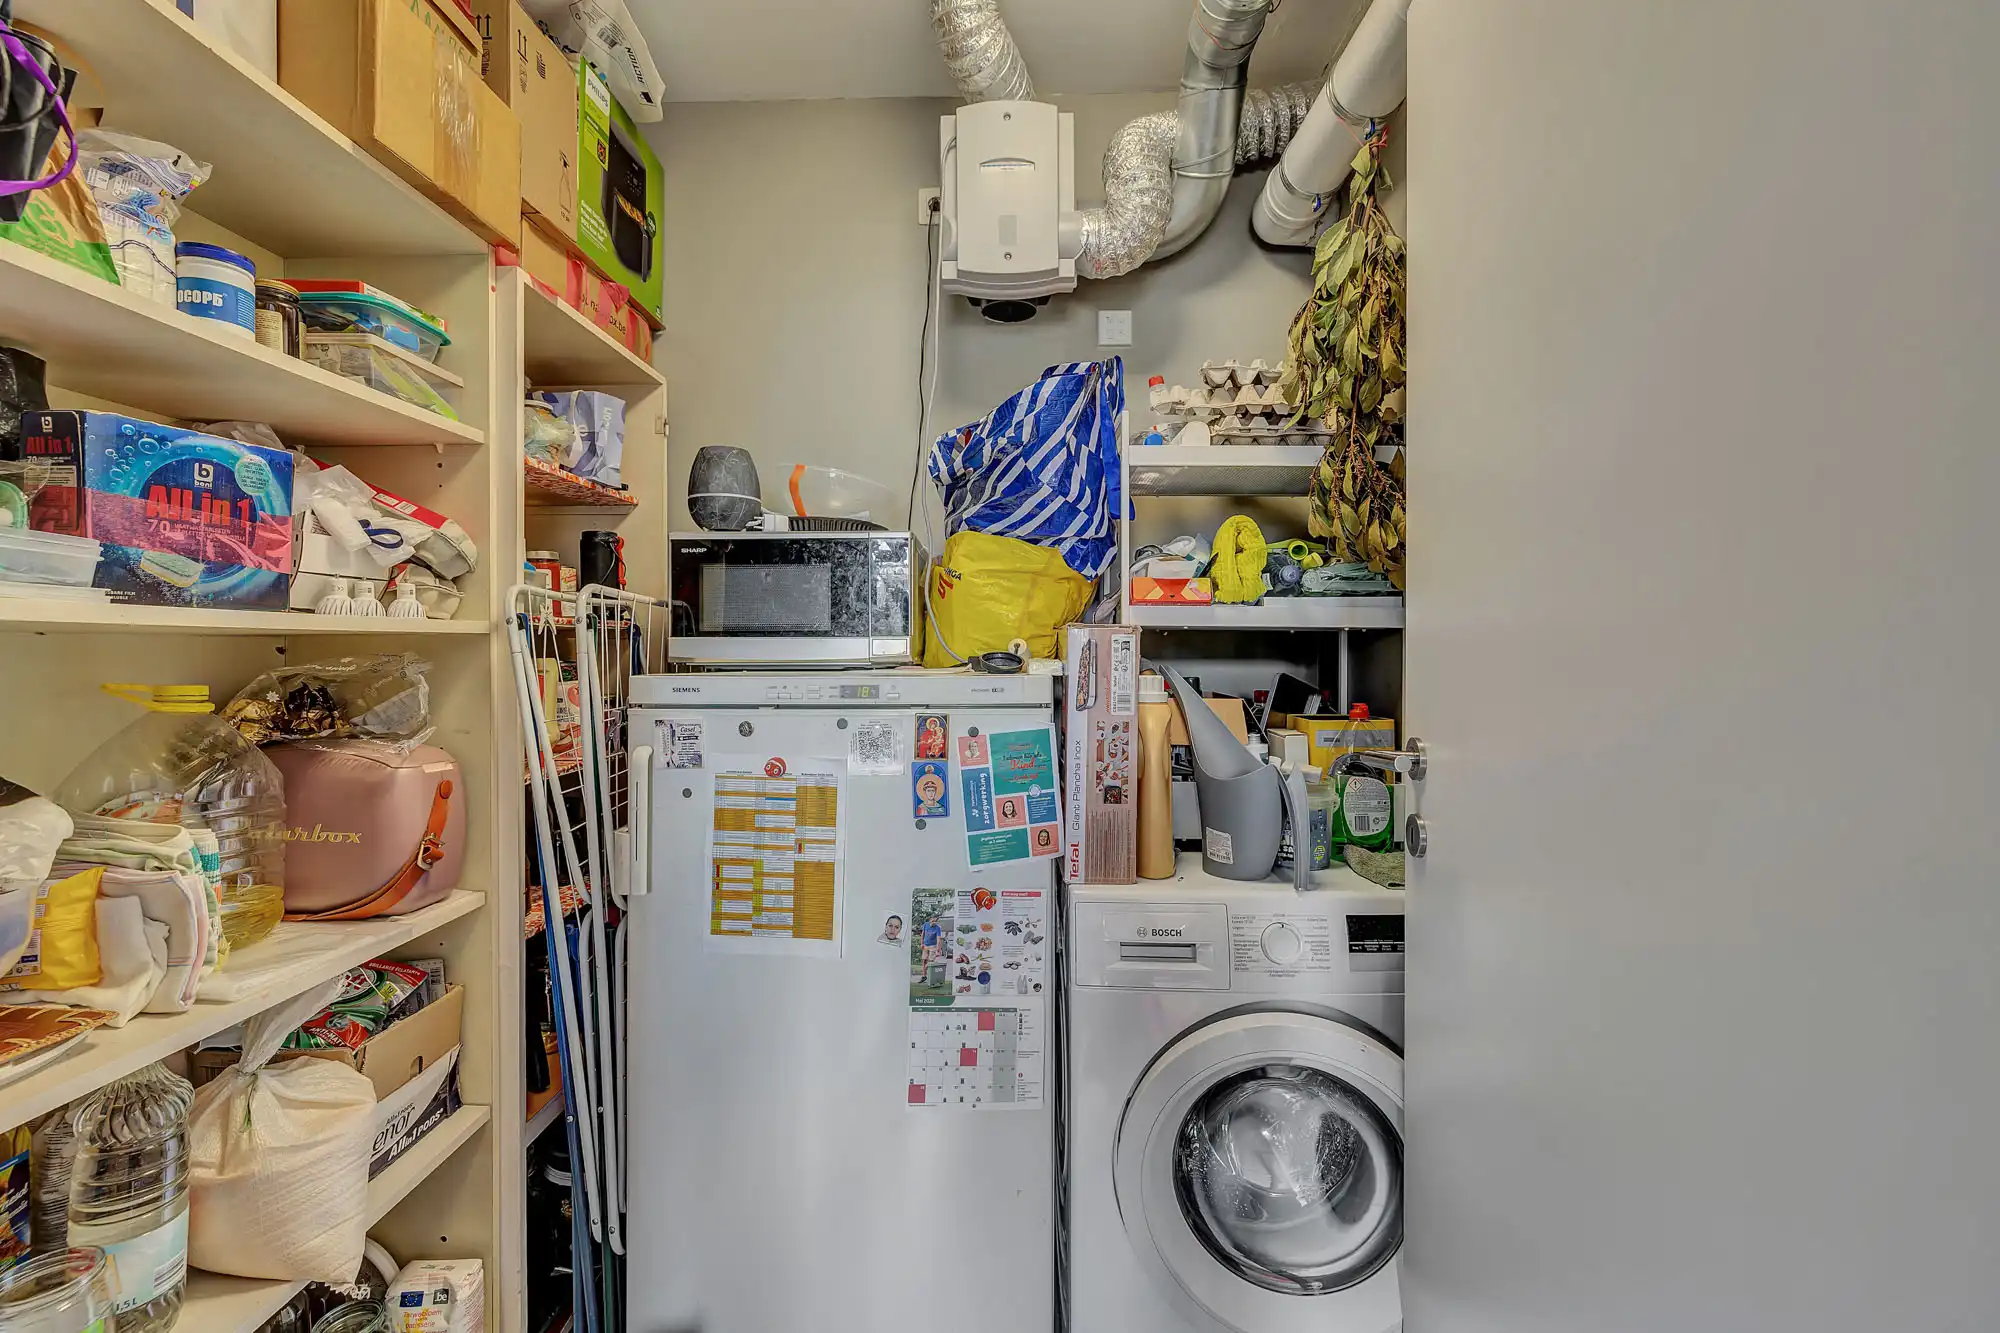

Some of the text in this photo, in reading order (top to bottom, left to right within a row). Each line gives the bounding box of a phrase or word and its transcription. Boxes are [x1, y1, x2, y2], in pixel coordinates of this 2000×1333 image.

[625, 46, 645, 84] ACTION
[588, 78, 609, 107] PHILIPS
[25, 435, 72, 454] All in 1
[194, 479, 213, 489] boni
[145, 485, 251, 528] All in 1
[146, 519, 171, 534] 70
[857, 686, 869, 697] 18
[979, 772, 991, 824] zorgwerking
[1069, 740, 1081, 881] Tefal Giant Plancha Inox
[1151, 928, 1182, 937] BOSCH
[370, 1105, 416, 1154] enor
